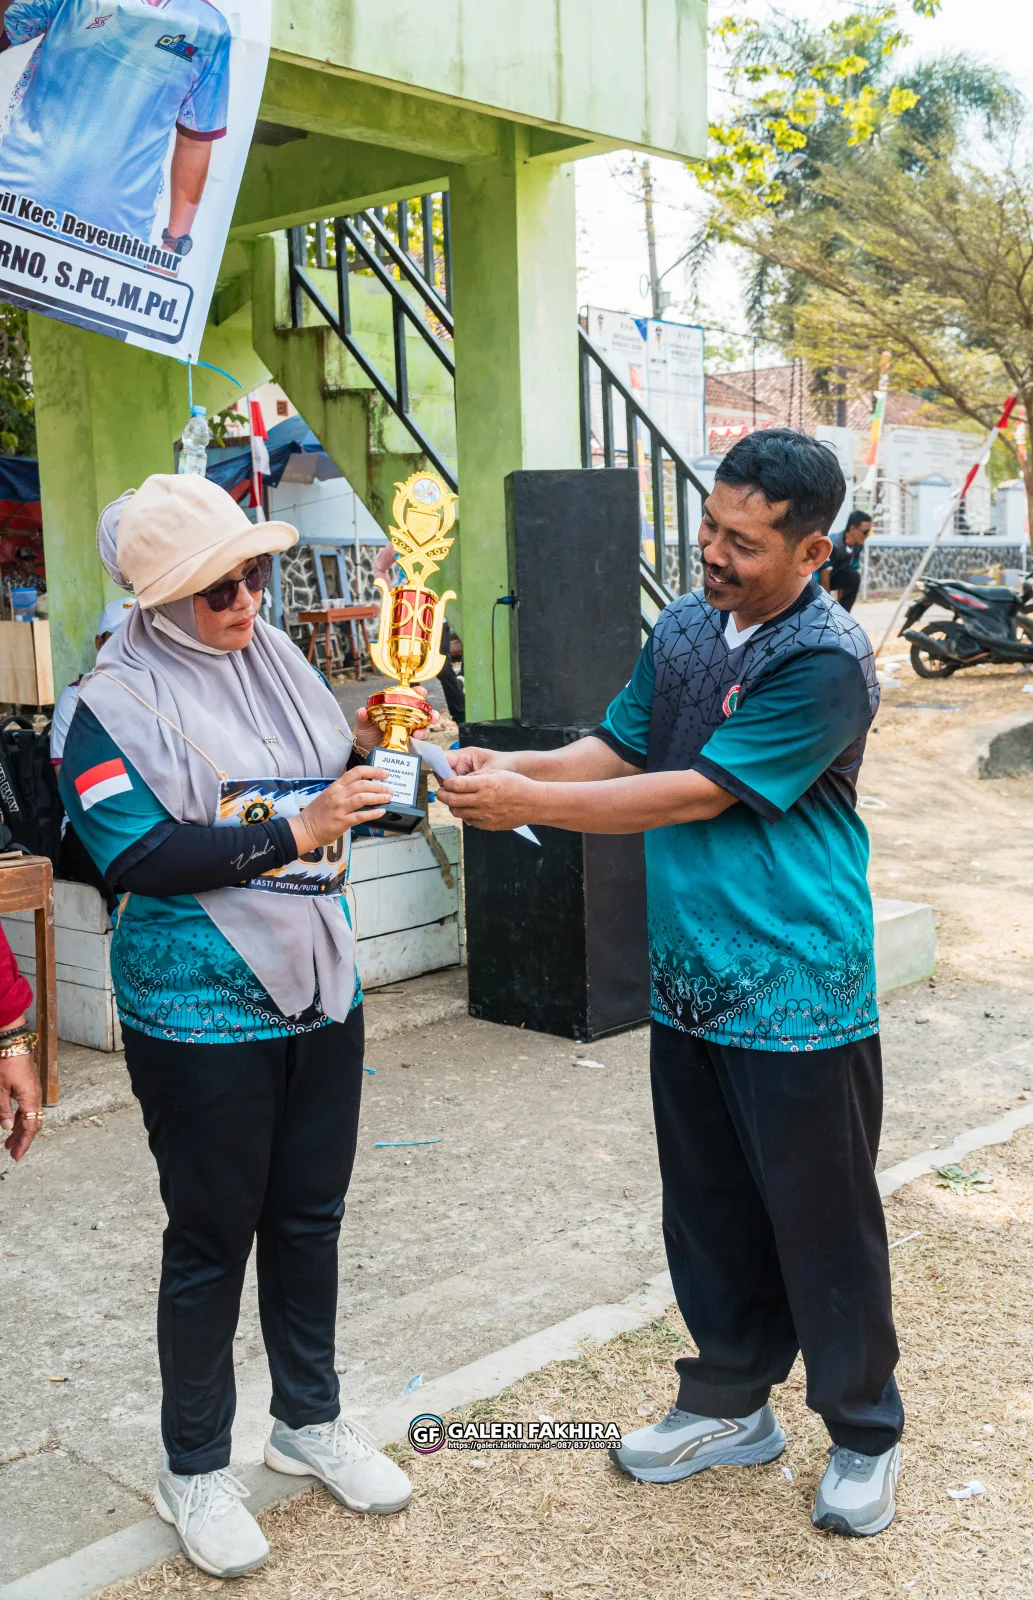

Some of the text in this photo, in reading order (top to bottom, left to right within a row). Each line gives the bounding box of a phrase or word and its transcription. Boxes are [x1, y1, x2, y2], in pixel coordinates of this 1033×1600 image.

[18, 198, 57, 229] Kec.
[62, 213, 182, 271] Dayeuhluhur
[55, 260, 179, 324] S.Pd.,M.Pd.
[382, 757, 405, 766] JUARA
[251, 878, 319, 892] KASTI PUTRA/PUTRI
